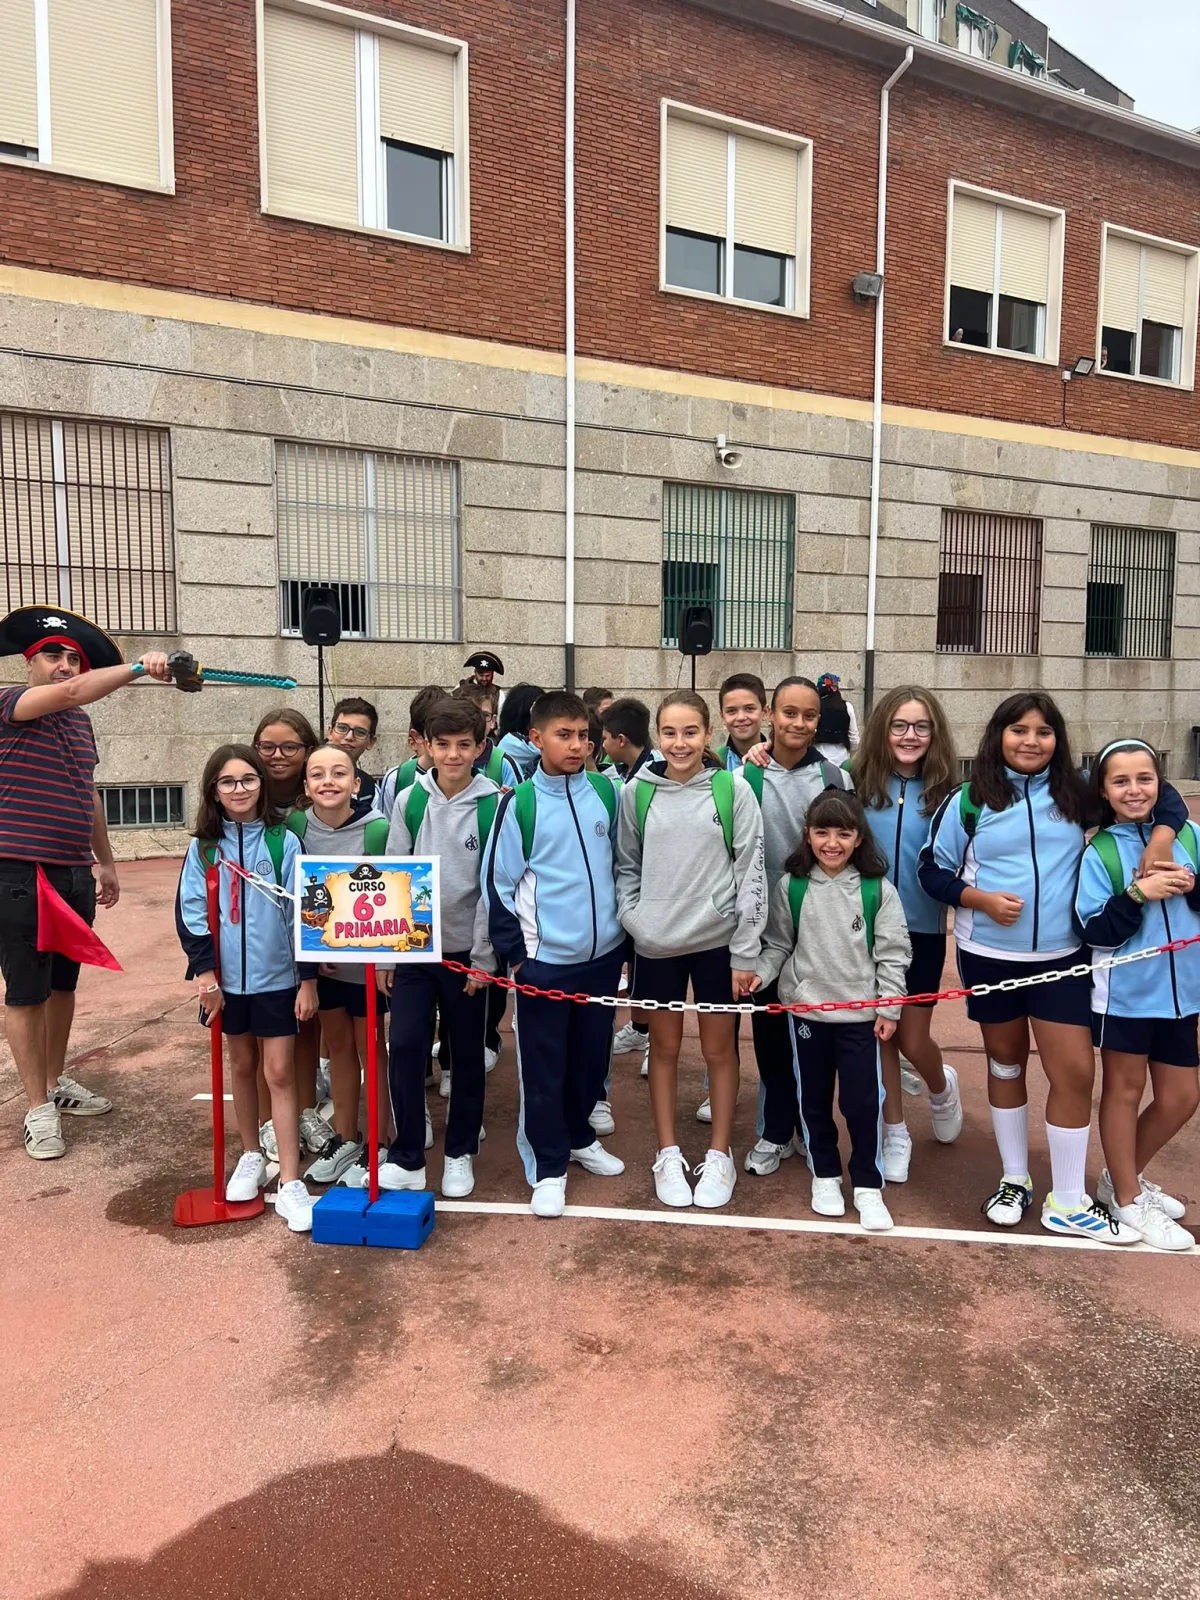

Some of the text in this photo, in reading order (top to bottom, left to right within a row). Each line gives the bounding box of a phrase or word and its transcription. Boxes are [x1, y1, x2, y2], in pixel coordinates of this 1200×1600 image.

[752, 874, 763, 885] la
[349, 881, 386, 892] CURSO
[751, 886, 763, 899] de
[334, 918, 411, 939] PRIMARIA
